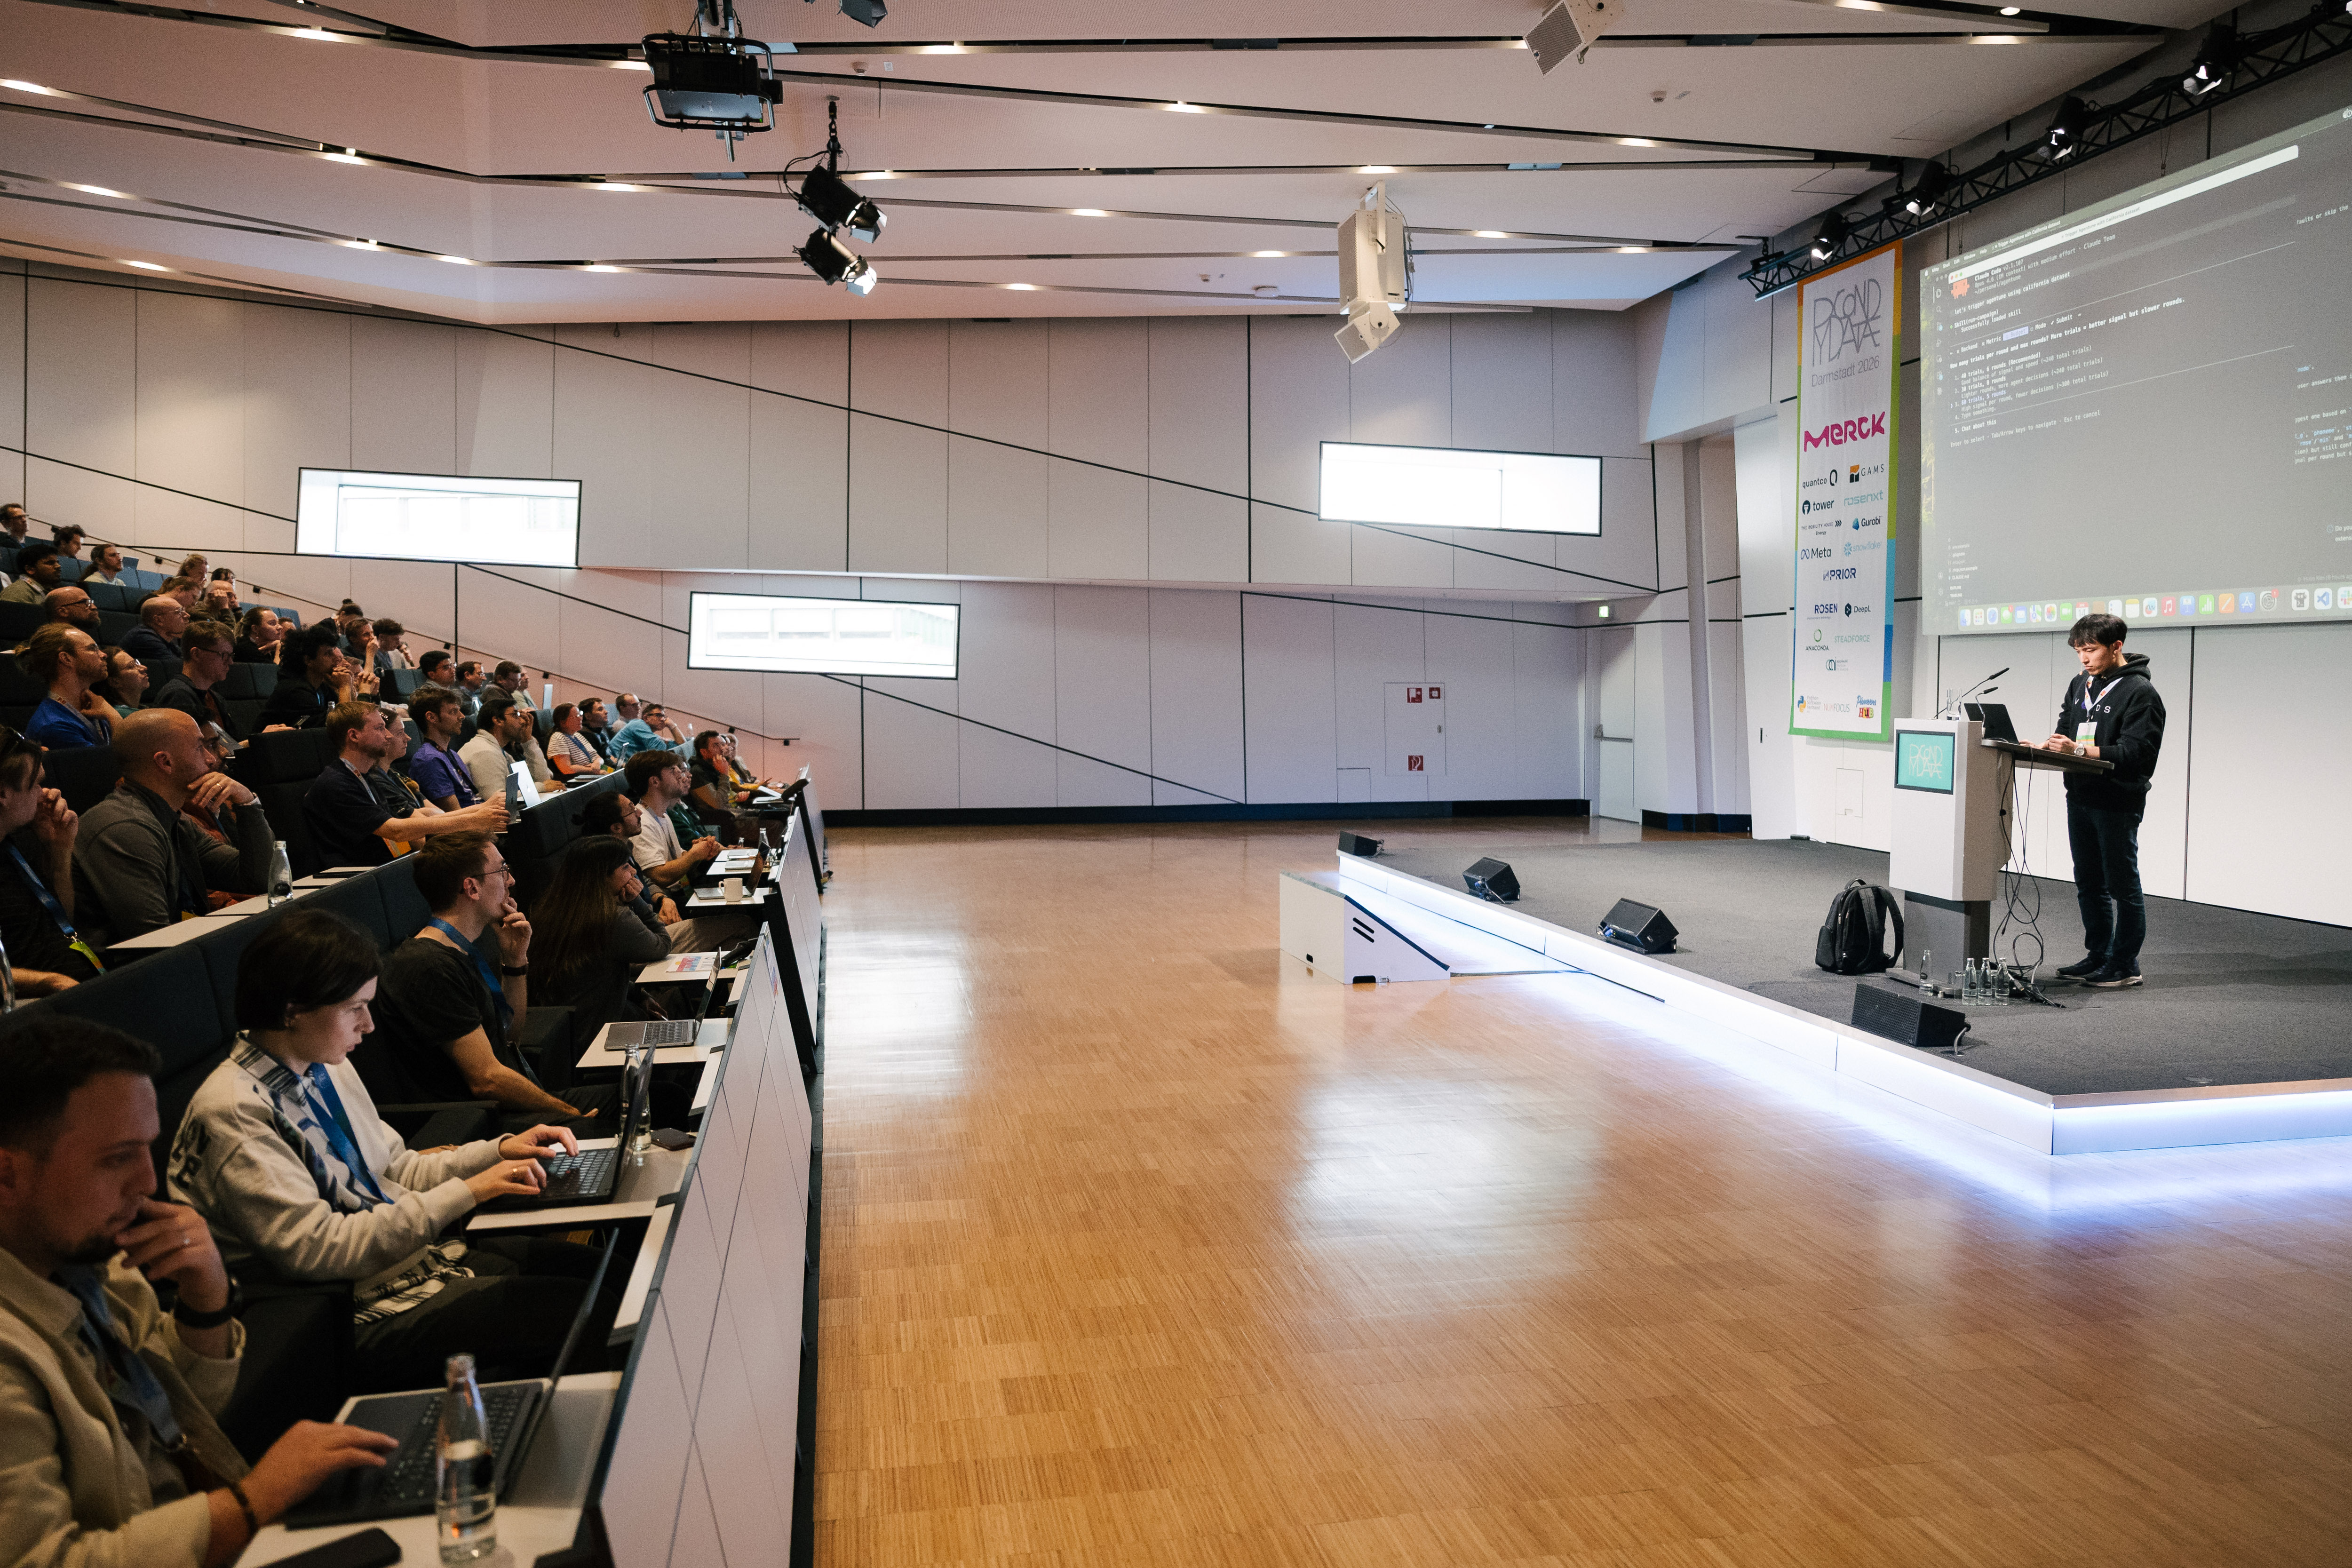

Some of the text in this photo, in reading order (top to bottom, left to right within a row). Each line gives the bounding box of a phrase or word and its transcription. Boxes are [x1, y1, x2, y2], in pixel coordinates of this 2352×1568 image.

[2065, 230, 2078, 238] Trigger
[2078, 223, 2097, 233] Agentune
[2105, 212, 2125, 223] California
[2124, 206, 2140, 216] dataset
[2005, 264, 2026, 278] context)
[2027, 260, 2039, 270] with
[2040, 255, 2057, 265] medium
[2058, 247, 2075, 259] effort
[2083, 239, 2100, 250] Claude
[2102, 234, 2114, 244] Team
[1975, 271, 1990, 281] Claude
[1991, 267, 2002, 276] Code
[1955, 270, 2070, 315] let's trigger agentune using california dataset
[1961, 308, 2021, 333] Successfully loaded skill
[1970, 354, 1985, 363] trials
[1996, 346, 2009, 356] round
[2010, 343, 2018, 352] and
[2030, 334, 2049, 346] rounds?
[2050, 332, 2062, 341] More
[2064, 326, 2081, 337] trials
[2088, 319, 2106, 330] better
[2108, 312, 2126, 324] signal
[2128, 309, 2138, 318] but
[2140, 304, 2159, 315] slower
[2161, 297, 2185, 309] rounds.
[1986, 335, 2002, 345] Metric
[2010, 327, 2026, 338] Budget
[2034, 322, 2047, 331] Mode
[2056, 313, 2073, 325] Submit
[1812, 355, 1880, 387] Darmstadt 2026
[1968, 368, 1985, 377] trials,
[1991, 361, 2006, 371] rounds
[2008, 351, 2041, 368] (Recommended)
[1972, 374, 1990, 383] balance
[1998, 366, 2014, 376] signal
[2015, 363, 2024, 372] and
[2025, 359, 2039, 369] speed
[2056, 350, 2070, 361] total
[2072, 344, 2092, 356] trials)
[1961, 390, 1978, 399] Lighter
[1979, 385, 1997, 395] rounds,
[2010, 377, 2024, 387] agent
[2025, 372, 2049, 383] decisions
[2066, 362, 2081, 372] total
[2082, 356, 2103, 368] trials)
[1968, 382, 1985, 391] trials,
[1991, 375, 2006, 385] rounds
[1961, 404, 1971, 413] High
[1972, 400, 1987, 410] signal
[1998, 394, 2014, 404] round,
[2015, 391, 2028, 399] fewer
[2030, 385, 2054, 396] decisions
[2072, 375, 2086, 385] total
[2088, 370, 2109, 382] trials)
[1968, 395, 1985, 404] trials,
[1991, 389, 2006, 398] rounds
[1972, 406, 1997, 416] something.
[1961, 424, 1971, 432] Chat
[1972, 421, 1985, 430] about
[1970, 434, 1985, 444] select
[1991, 430, 2013, 439] Tab/Arrow
[2035, 419, 2057, 430] navigate
[2082, 409, 2100, 420] cancel
[1861, 464, 1884, 477] GAMS
[1802, 478, 1827, 489] quantco
[1812, 500, 1834, 511] tower
[1843, 490, 1883, 507] rosenxt
[1861, 516, 1881, 527] Gurobi
[1811, 547, 1832, 559] Meta
[1852, 541, 1881, 552] snowflake
[1829, 568, 1856, 581] PRIOR
[1814, 603, 1838, 614] ROSEN
[1854, 605, 1871, 614] DeepL
[1835, 635, 1870, 643] STEADFORCE
[1823, 703, 1850, 712] NUMFOCUS
